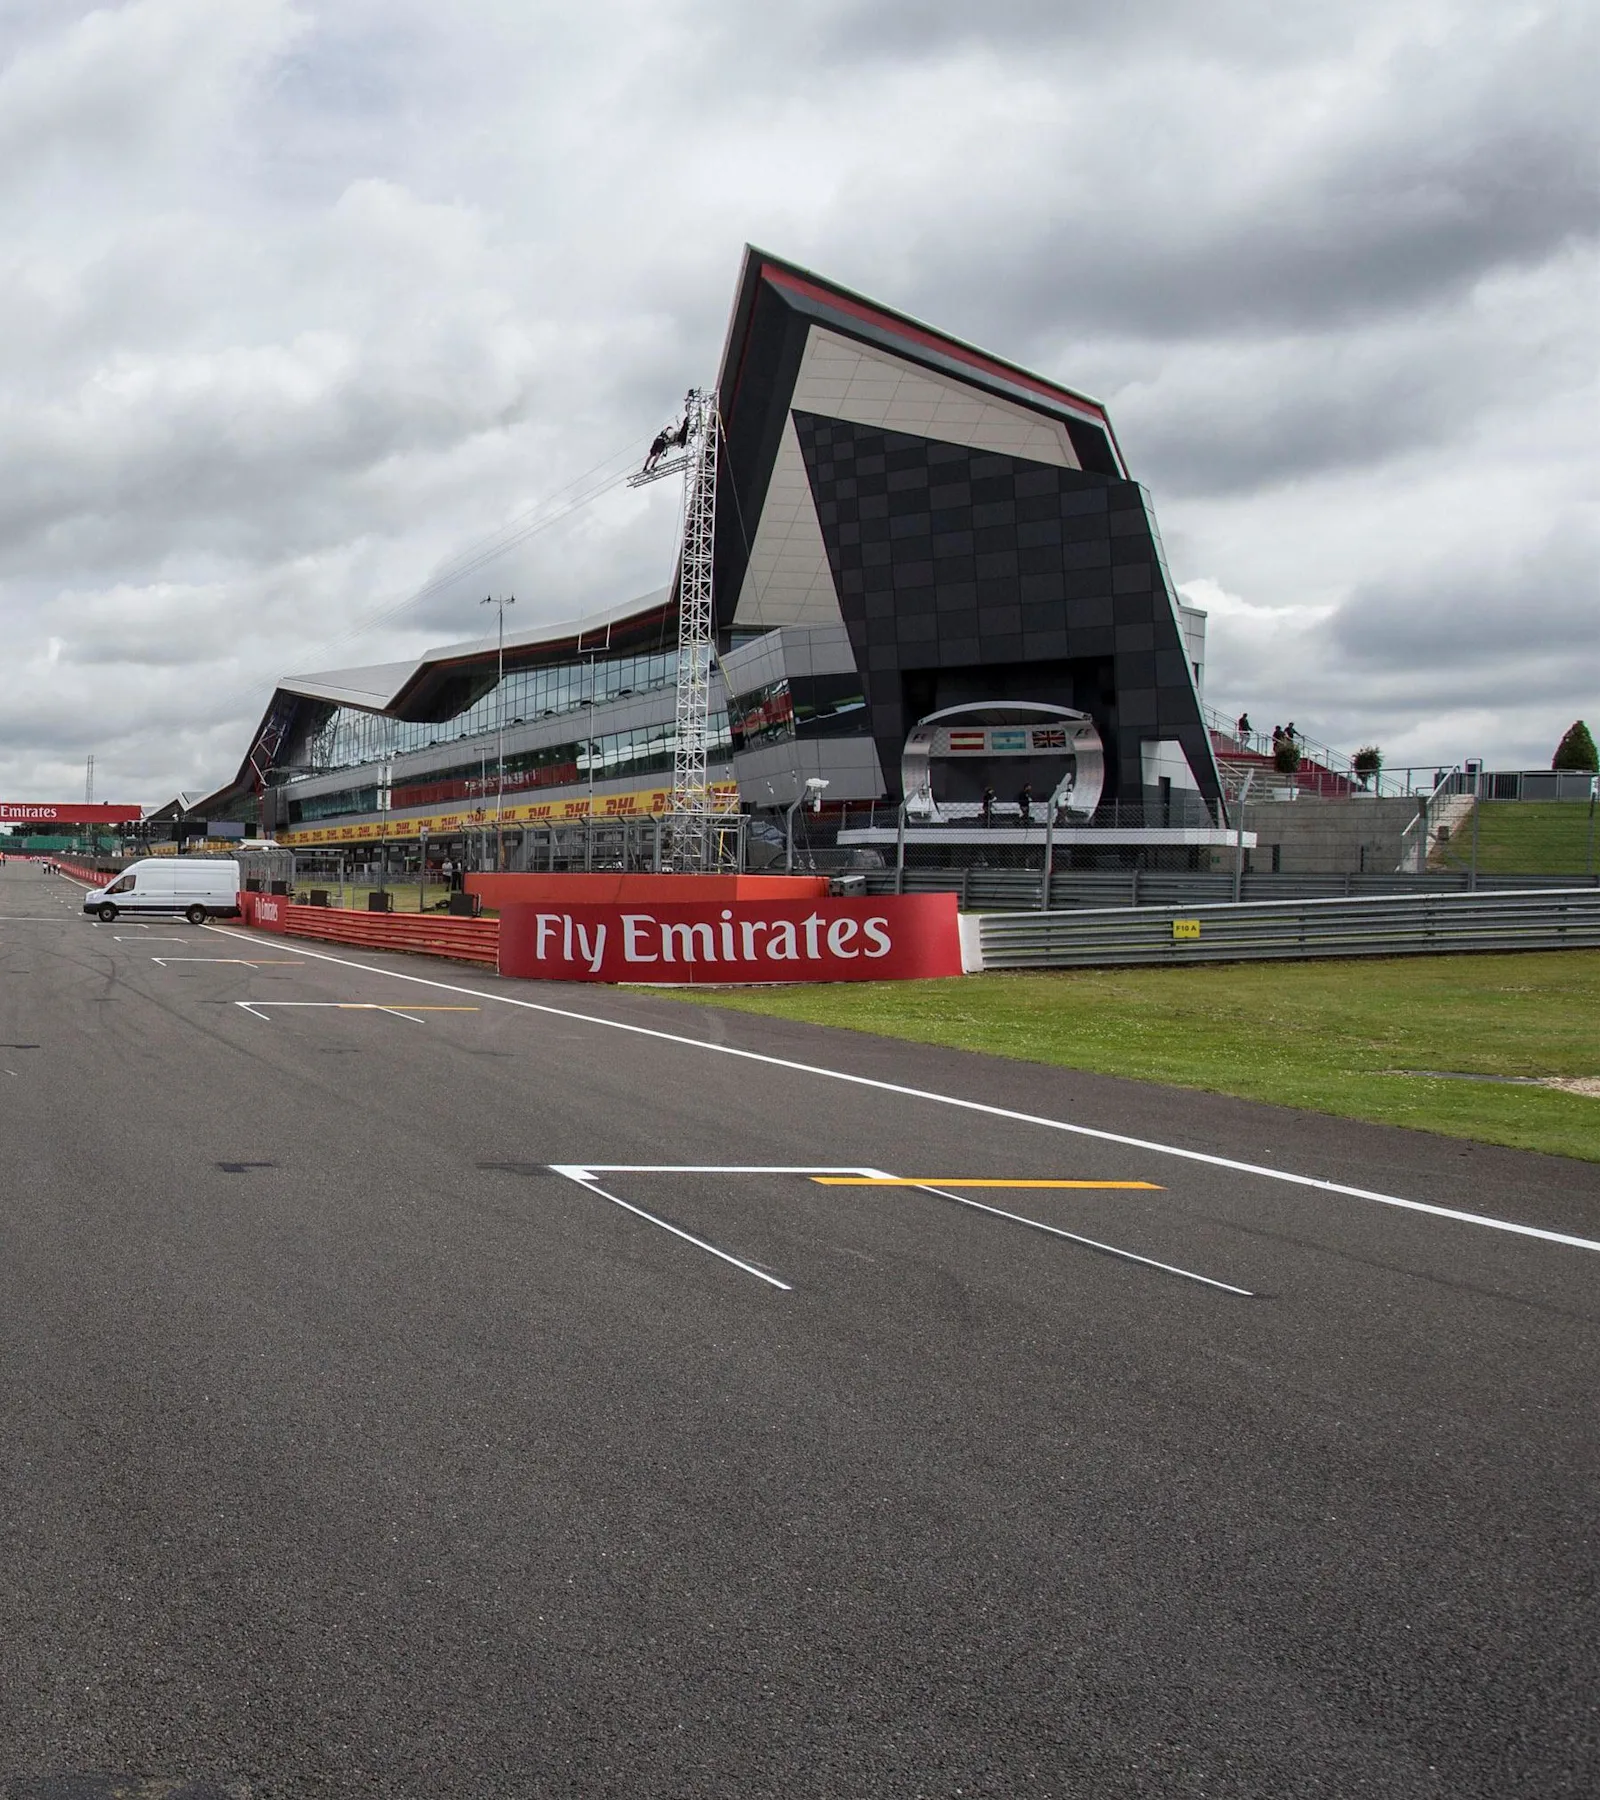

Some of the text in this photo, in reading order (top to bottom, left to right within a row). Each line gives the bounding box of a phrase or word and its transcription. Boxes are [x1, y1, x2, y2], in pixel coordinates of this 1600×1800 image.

[0, 804, 57, 818] Emirates
[528, 806, 551, 819] DHL
[564, 801, 591, 817] DHL
[606, 796, 637, 815] DHL
[535, 909, 891, 973] Fly Emirates
